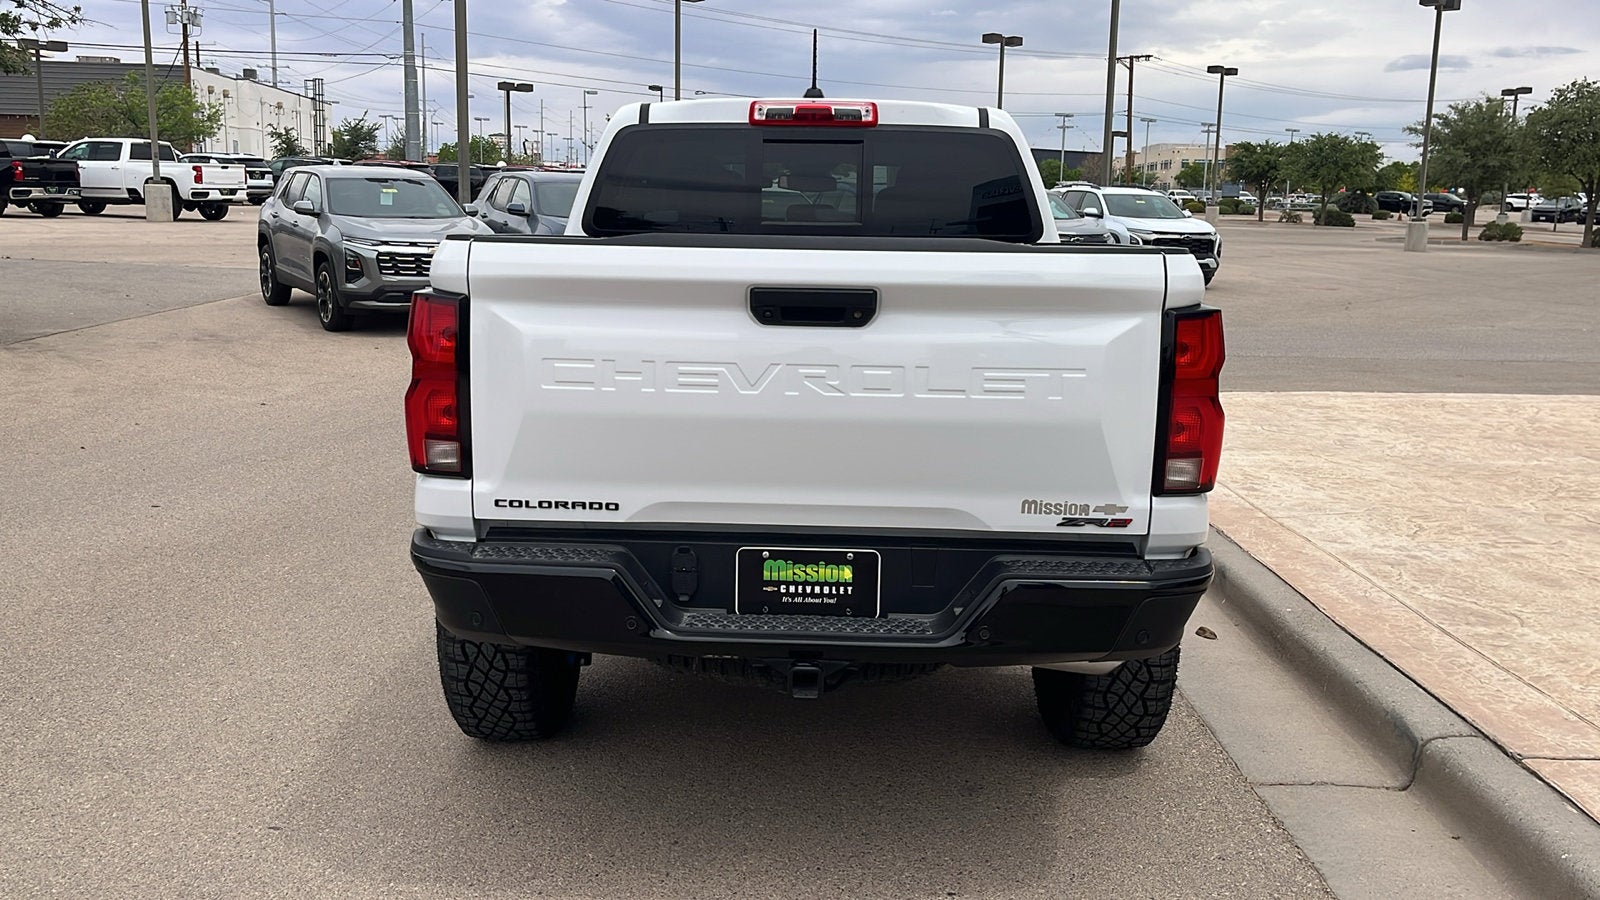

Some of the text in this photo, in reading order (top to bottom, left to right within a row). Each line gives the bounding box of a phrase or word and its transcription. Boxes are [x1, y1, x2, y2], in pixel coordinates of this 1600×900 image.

[541, 358, 1087, 400] CHEVROLET
[494, 498, 620, 511] COLORADO
[1021, 499, 1091, 516] Mission
[1056, 517, 1133, 528] ZR2
[763, 559, 853, 582] Mission
[780, 584, 853, 594] CHEVROLET
